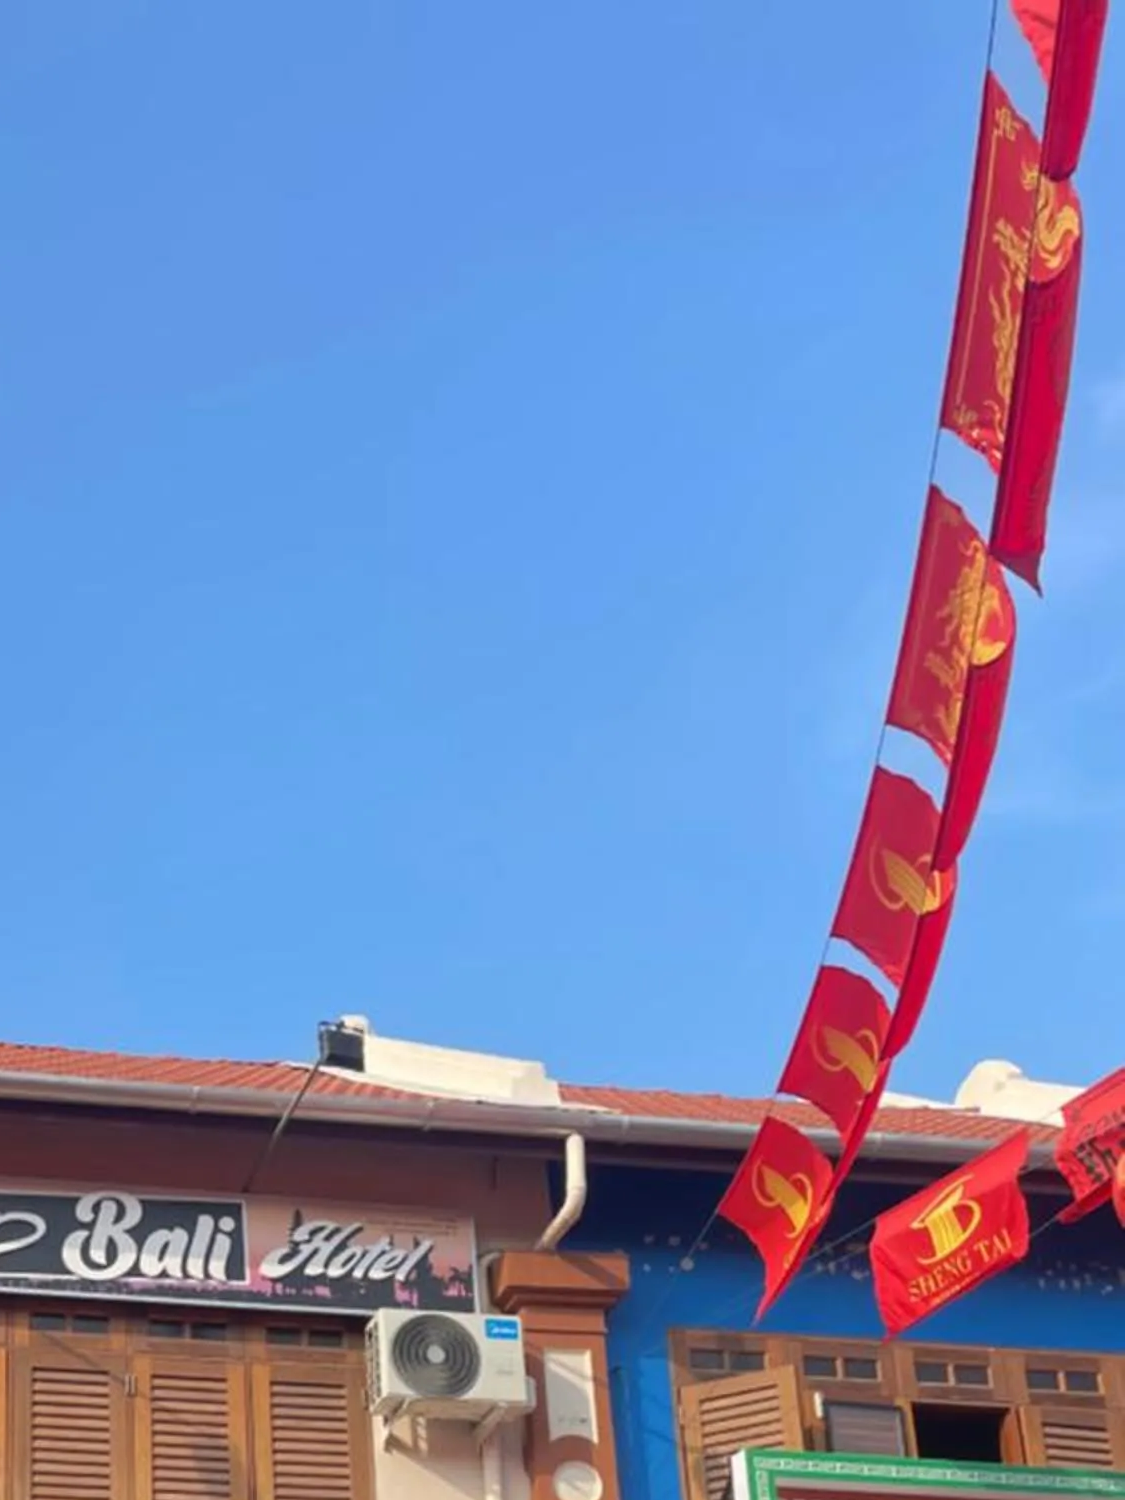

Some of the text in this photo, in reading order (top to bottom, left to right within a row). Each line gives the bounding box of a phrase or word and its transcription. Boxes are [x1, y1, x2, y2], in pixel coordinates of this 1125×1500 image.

[62, 1192, 236, 1285] Bali
[259, 1219, 435, 1283] Hotel
[909, 1255, 973, 1303] SHENG
[974, 1227, 1013, 1264] TAI
